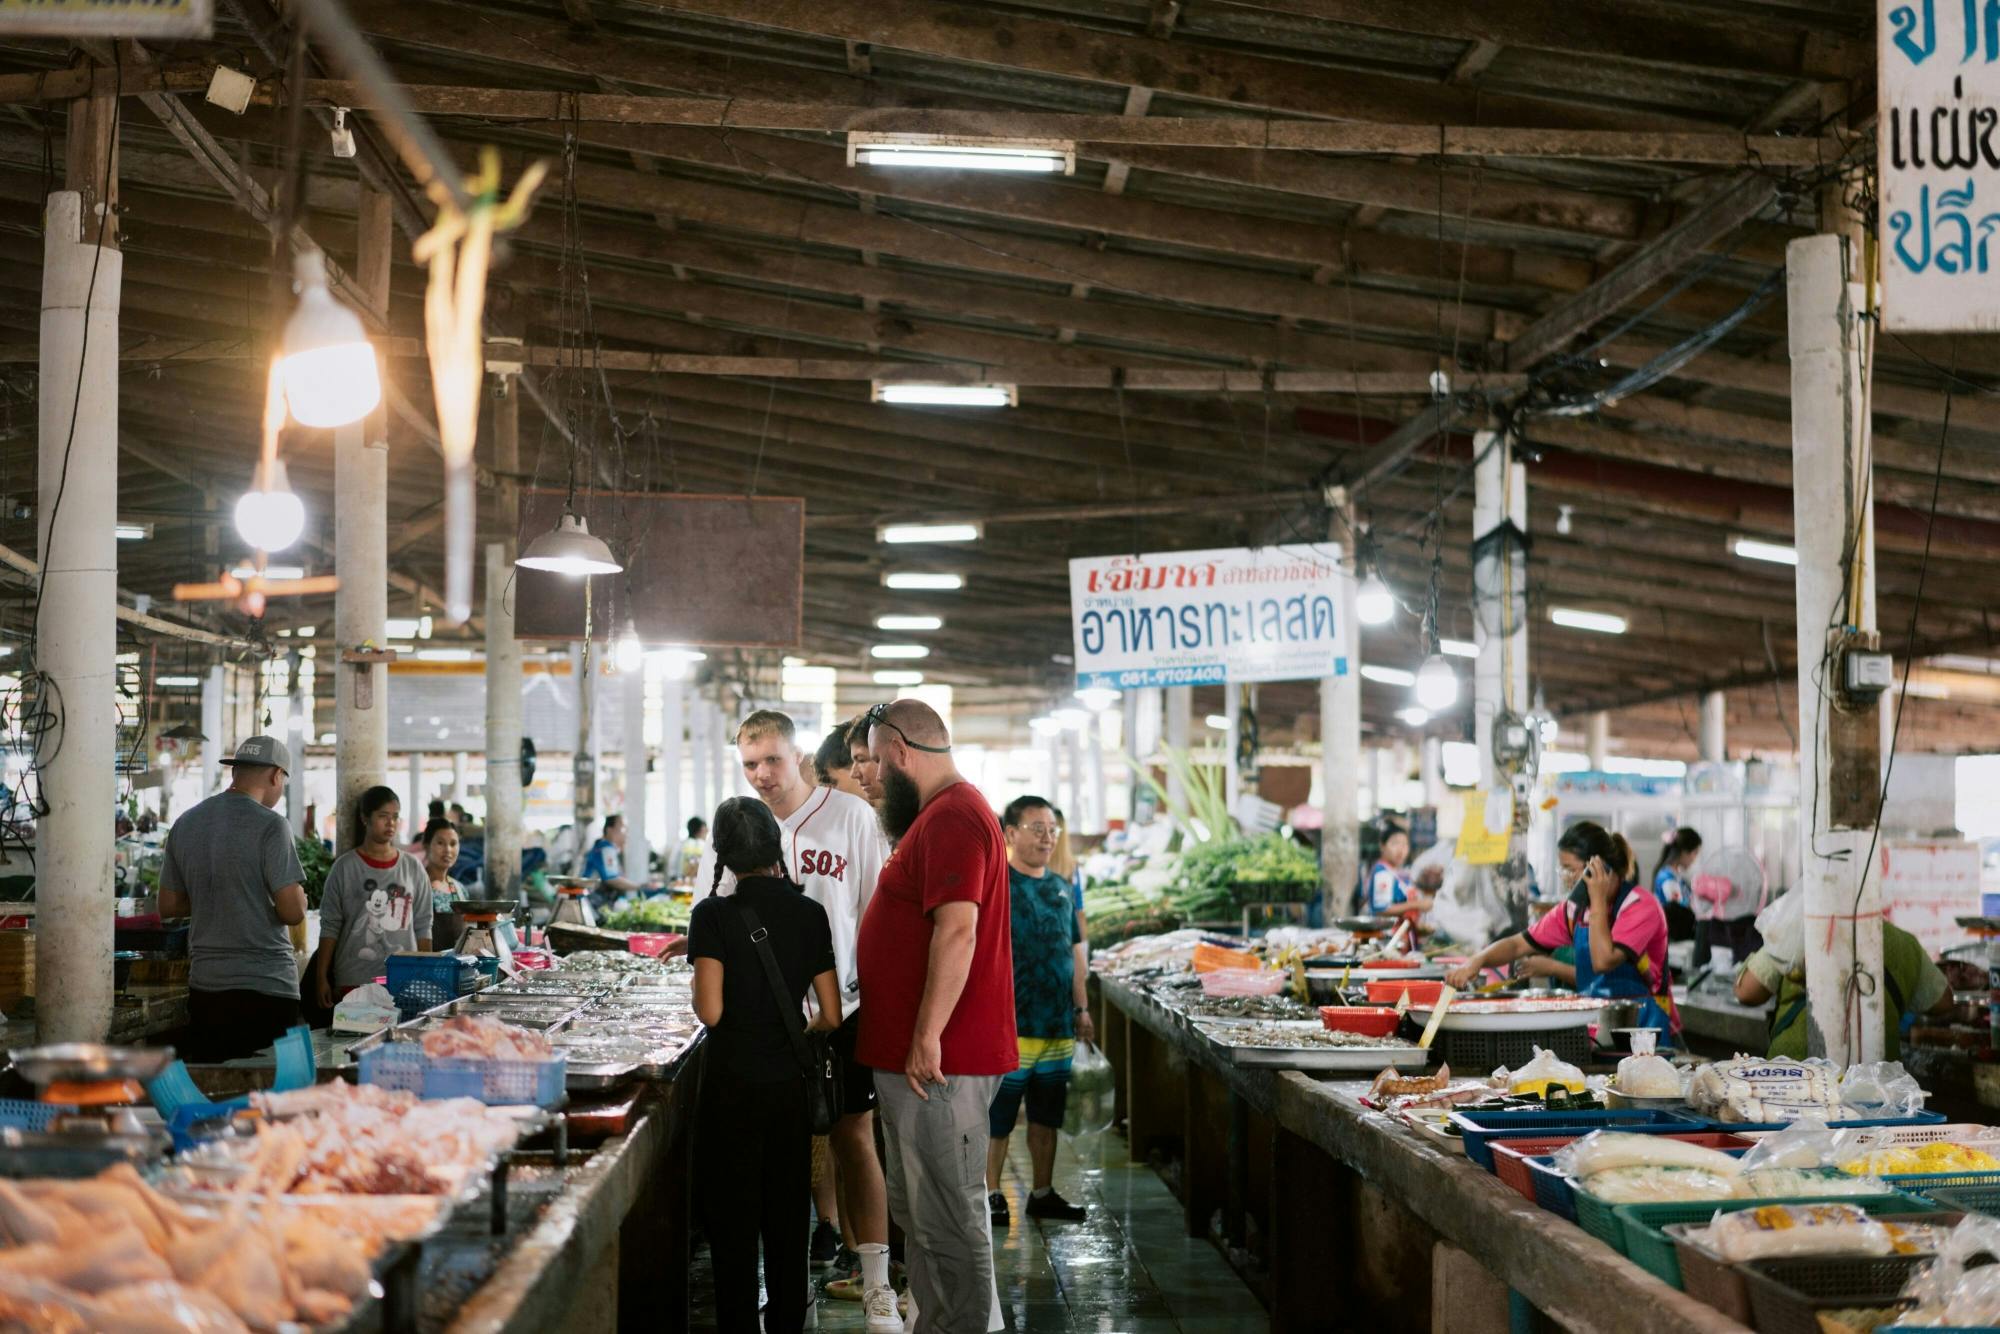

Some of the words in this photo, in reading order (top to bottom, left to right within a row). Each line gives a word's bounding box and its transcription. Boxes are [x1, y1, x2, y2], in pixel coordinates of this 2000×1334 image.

[1081, 594, 1335, 655] อาหารทะเลสด
[801, 849, 848, 882] SOX
